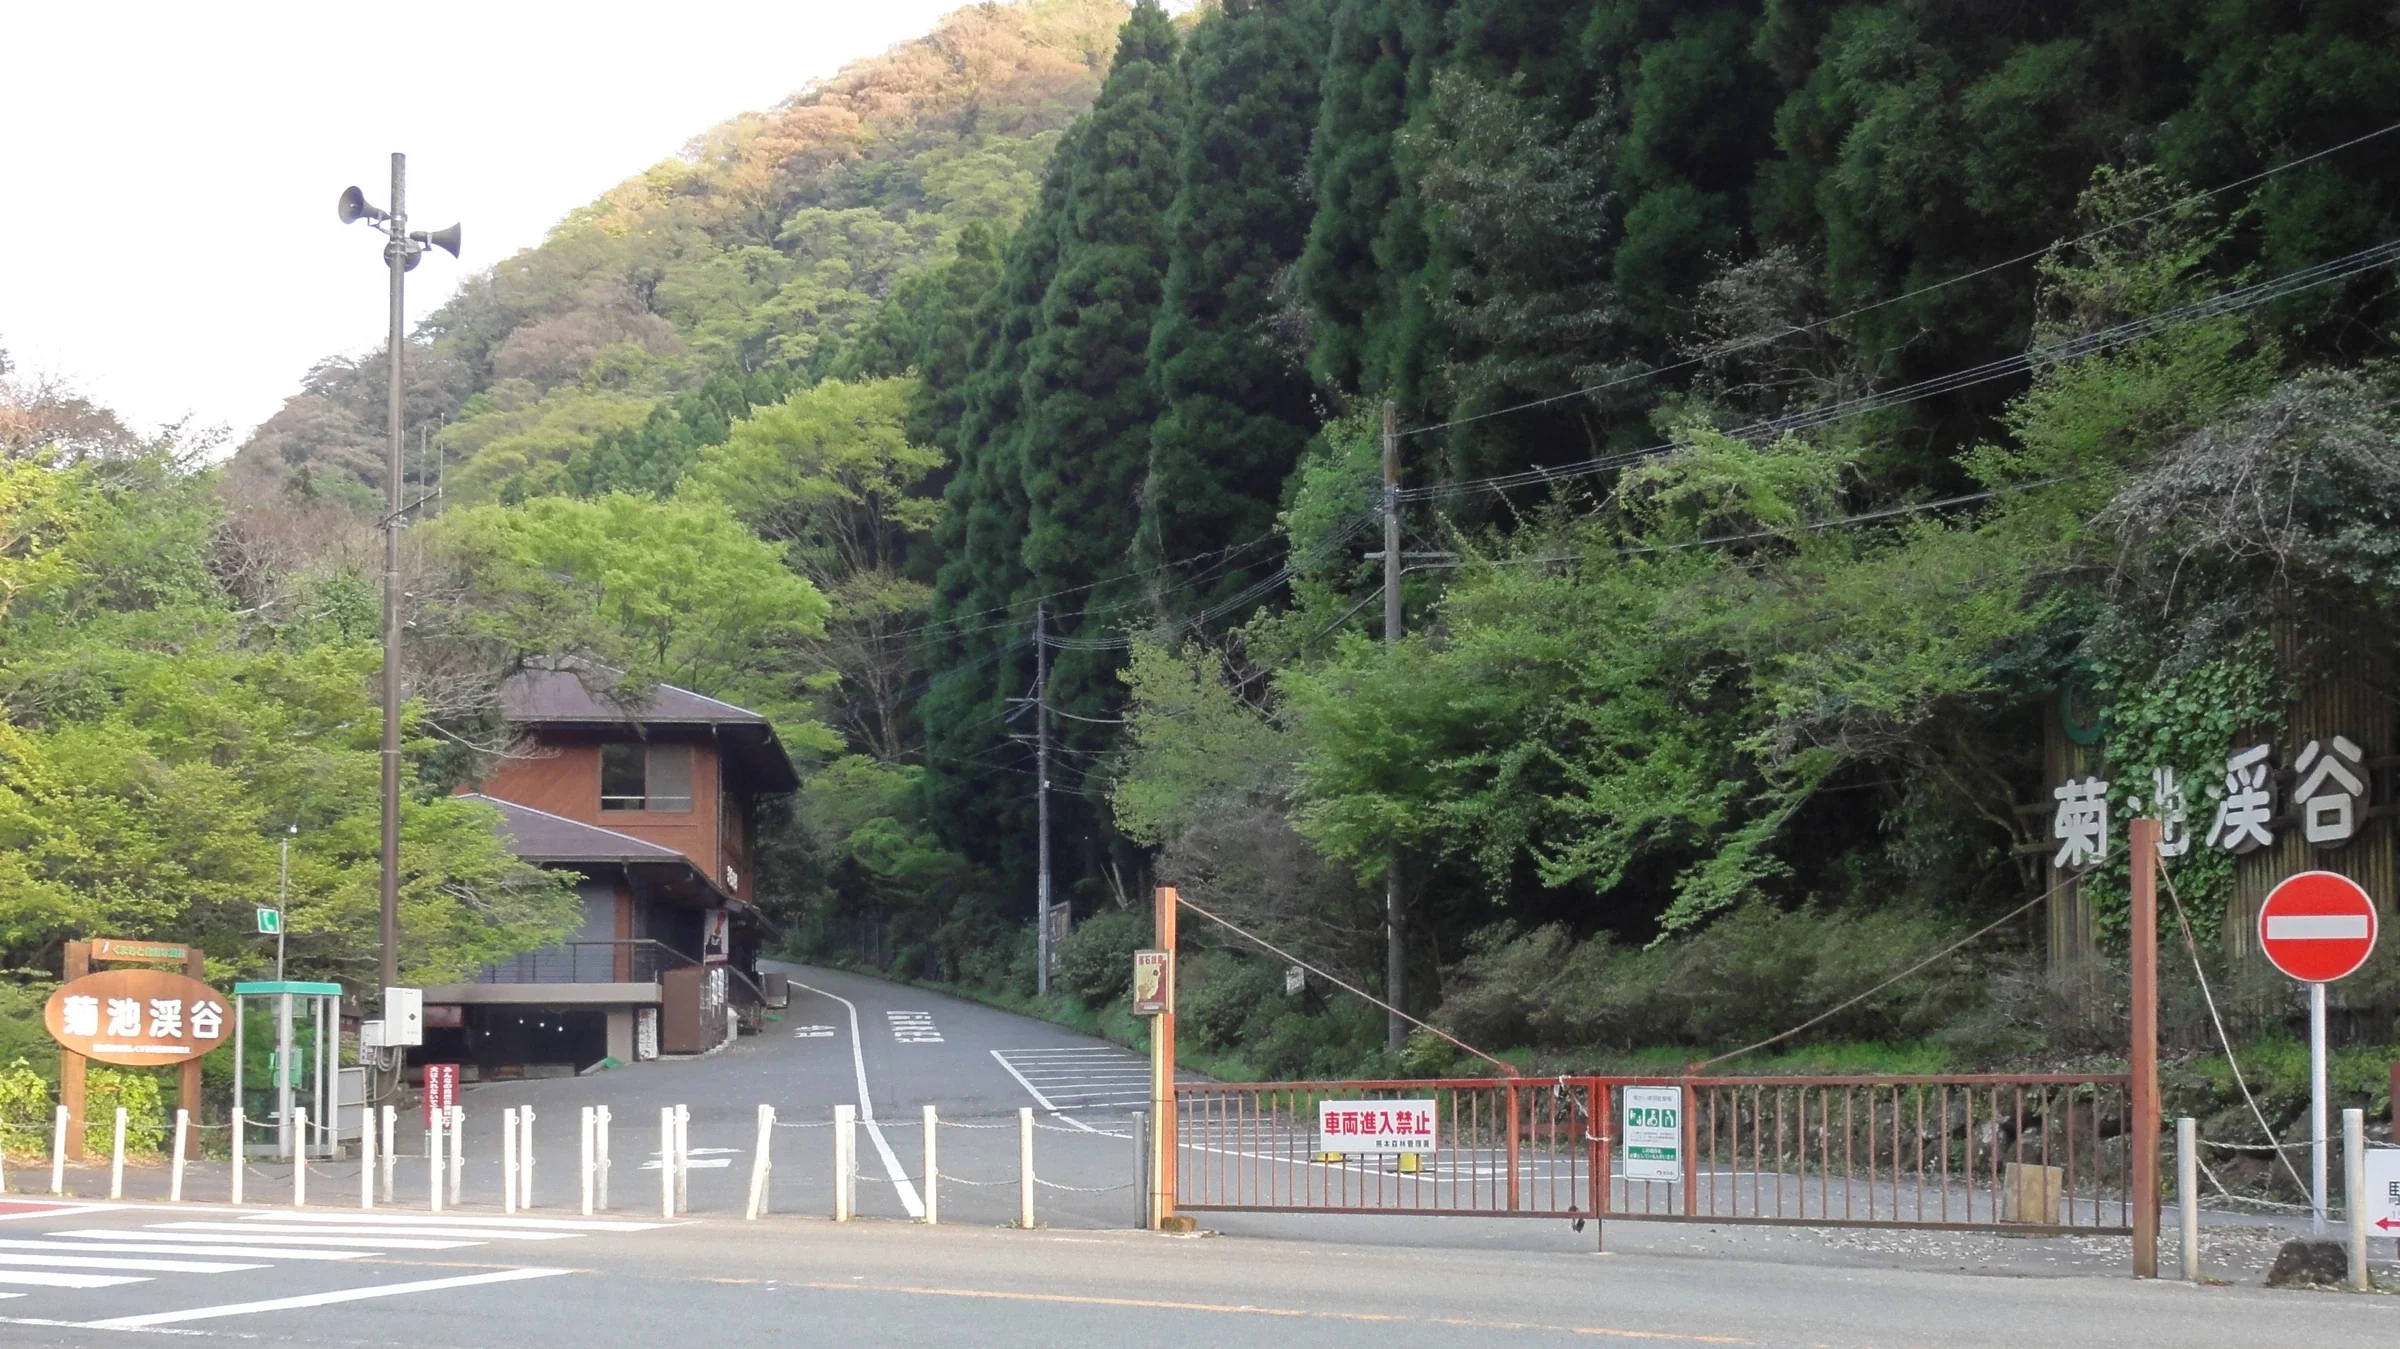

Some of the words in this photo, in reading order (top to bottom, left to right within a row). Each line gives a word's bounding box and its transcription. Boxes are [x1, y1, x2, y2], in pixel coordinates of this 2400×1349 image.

[63, 995, 223, 1040] 菊池渓谷
[1325, 1110, 1431, 1136] 車両進入禁止
